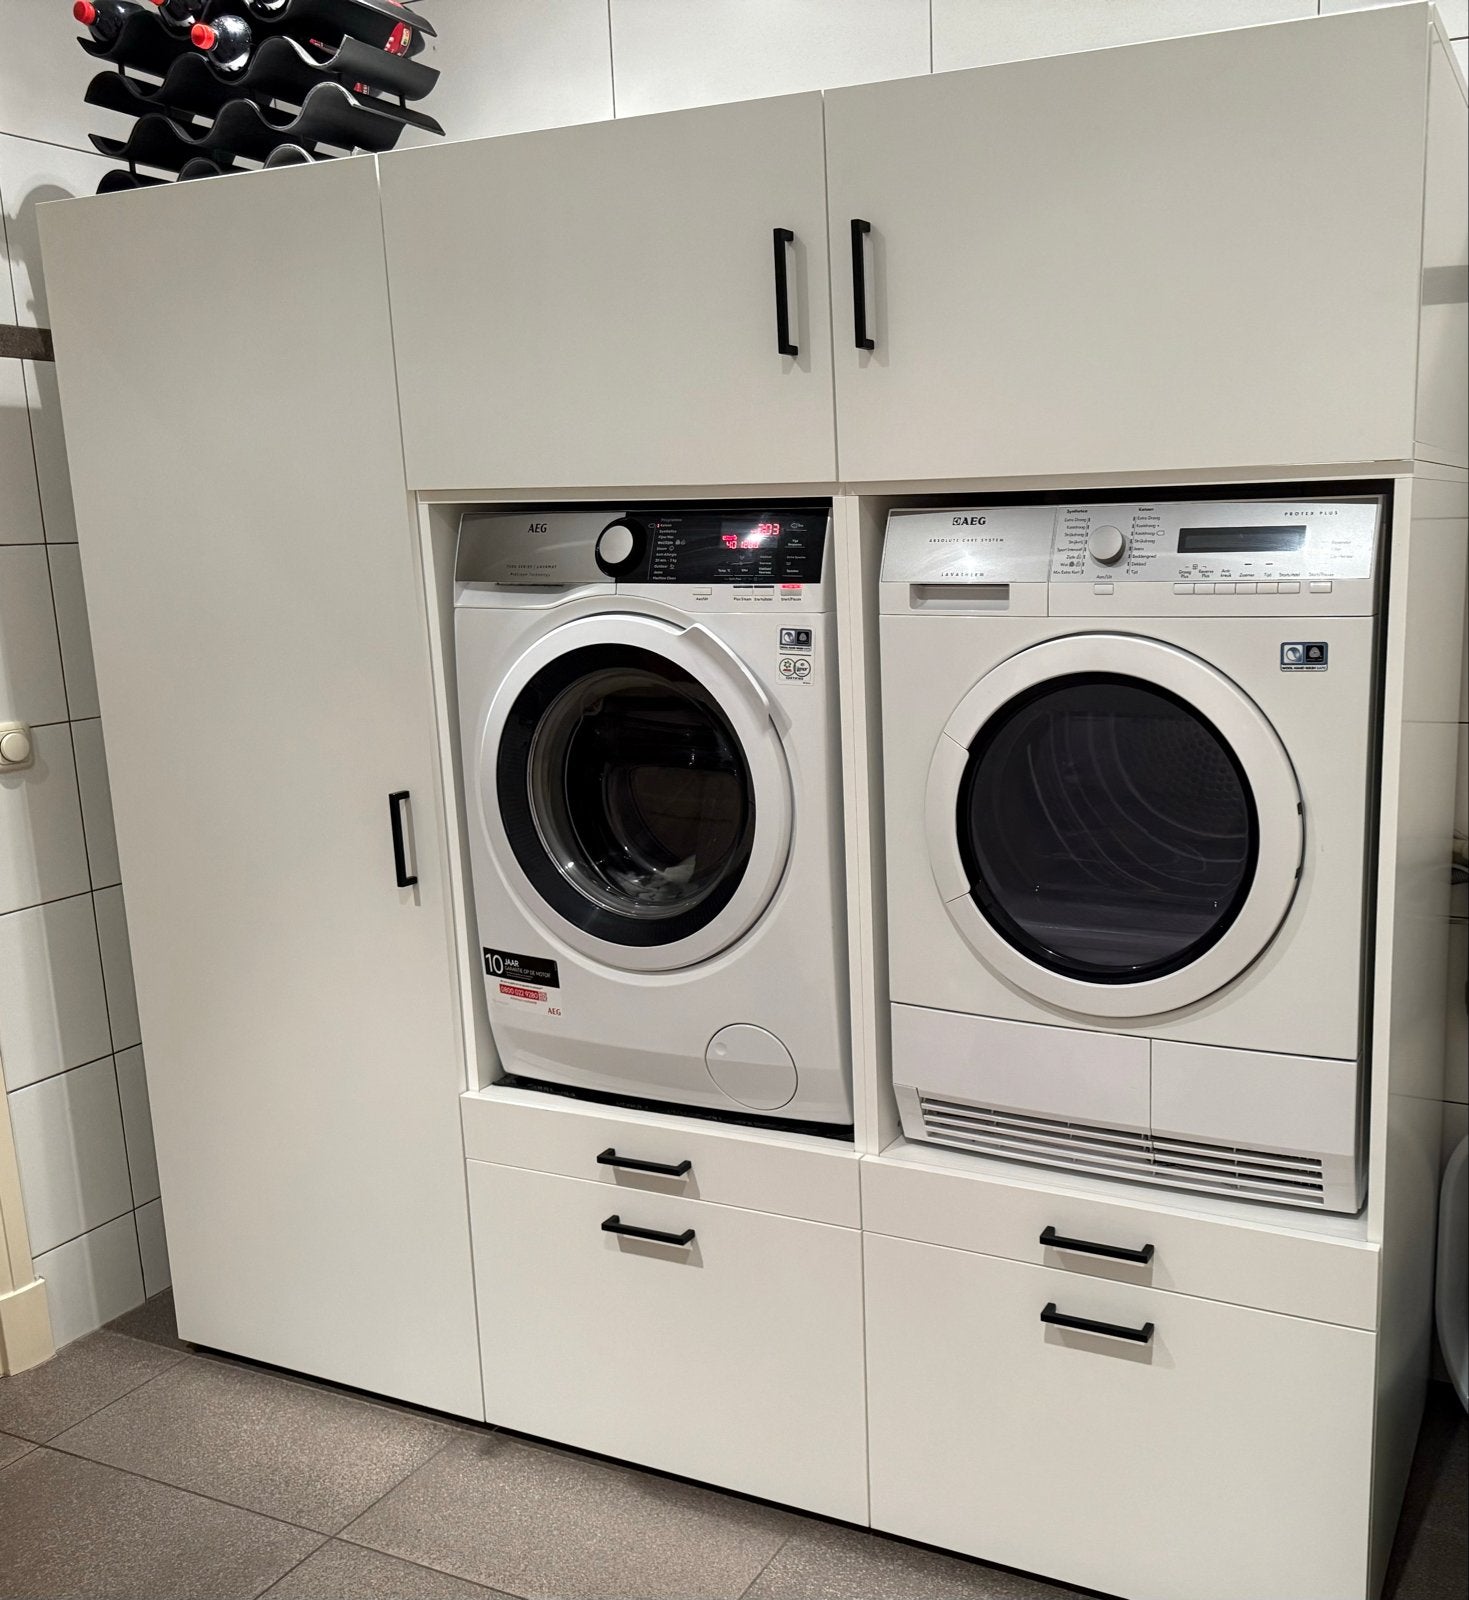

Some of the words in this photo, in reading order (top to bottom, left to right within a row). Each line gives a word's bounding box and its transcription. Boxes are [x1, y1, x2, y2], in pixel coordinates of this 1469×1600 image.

[962, 517, 986, 526] AEG
[528, 524, 547, 533] AEG
[486, 954, 503, 974] 10
[504, 959, 519, 967] JAAR
